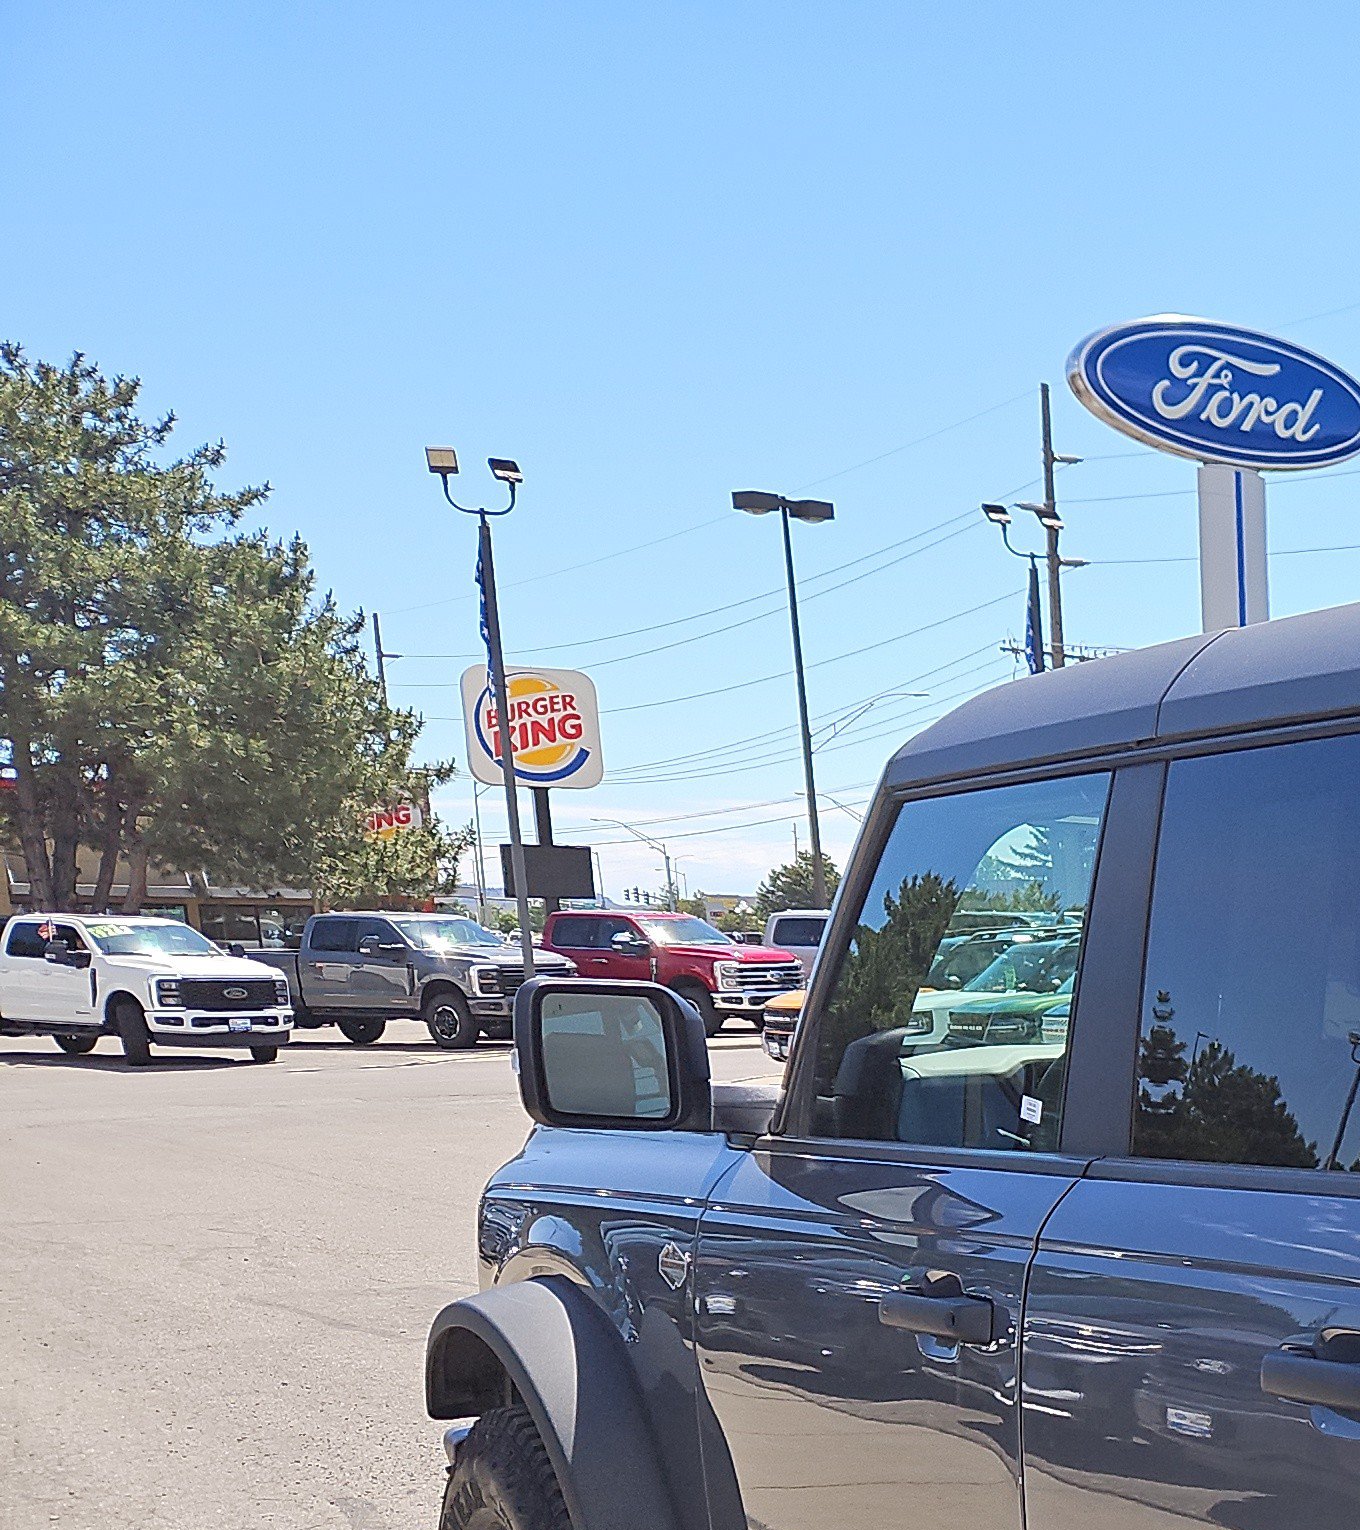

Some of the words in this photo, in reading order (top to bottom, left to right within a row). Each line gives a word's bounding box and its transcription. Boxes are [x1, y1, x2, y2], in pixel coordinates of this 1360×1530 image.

[1152, 345, 1324, 442] Ford
[486, 694, 577, 729] BURGER
[493, 713, 583, 758] KING
[367, 804, 411, 831] ING
